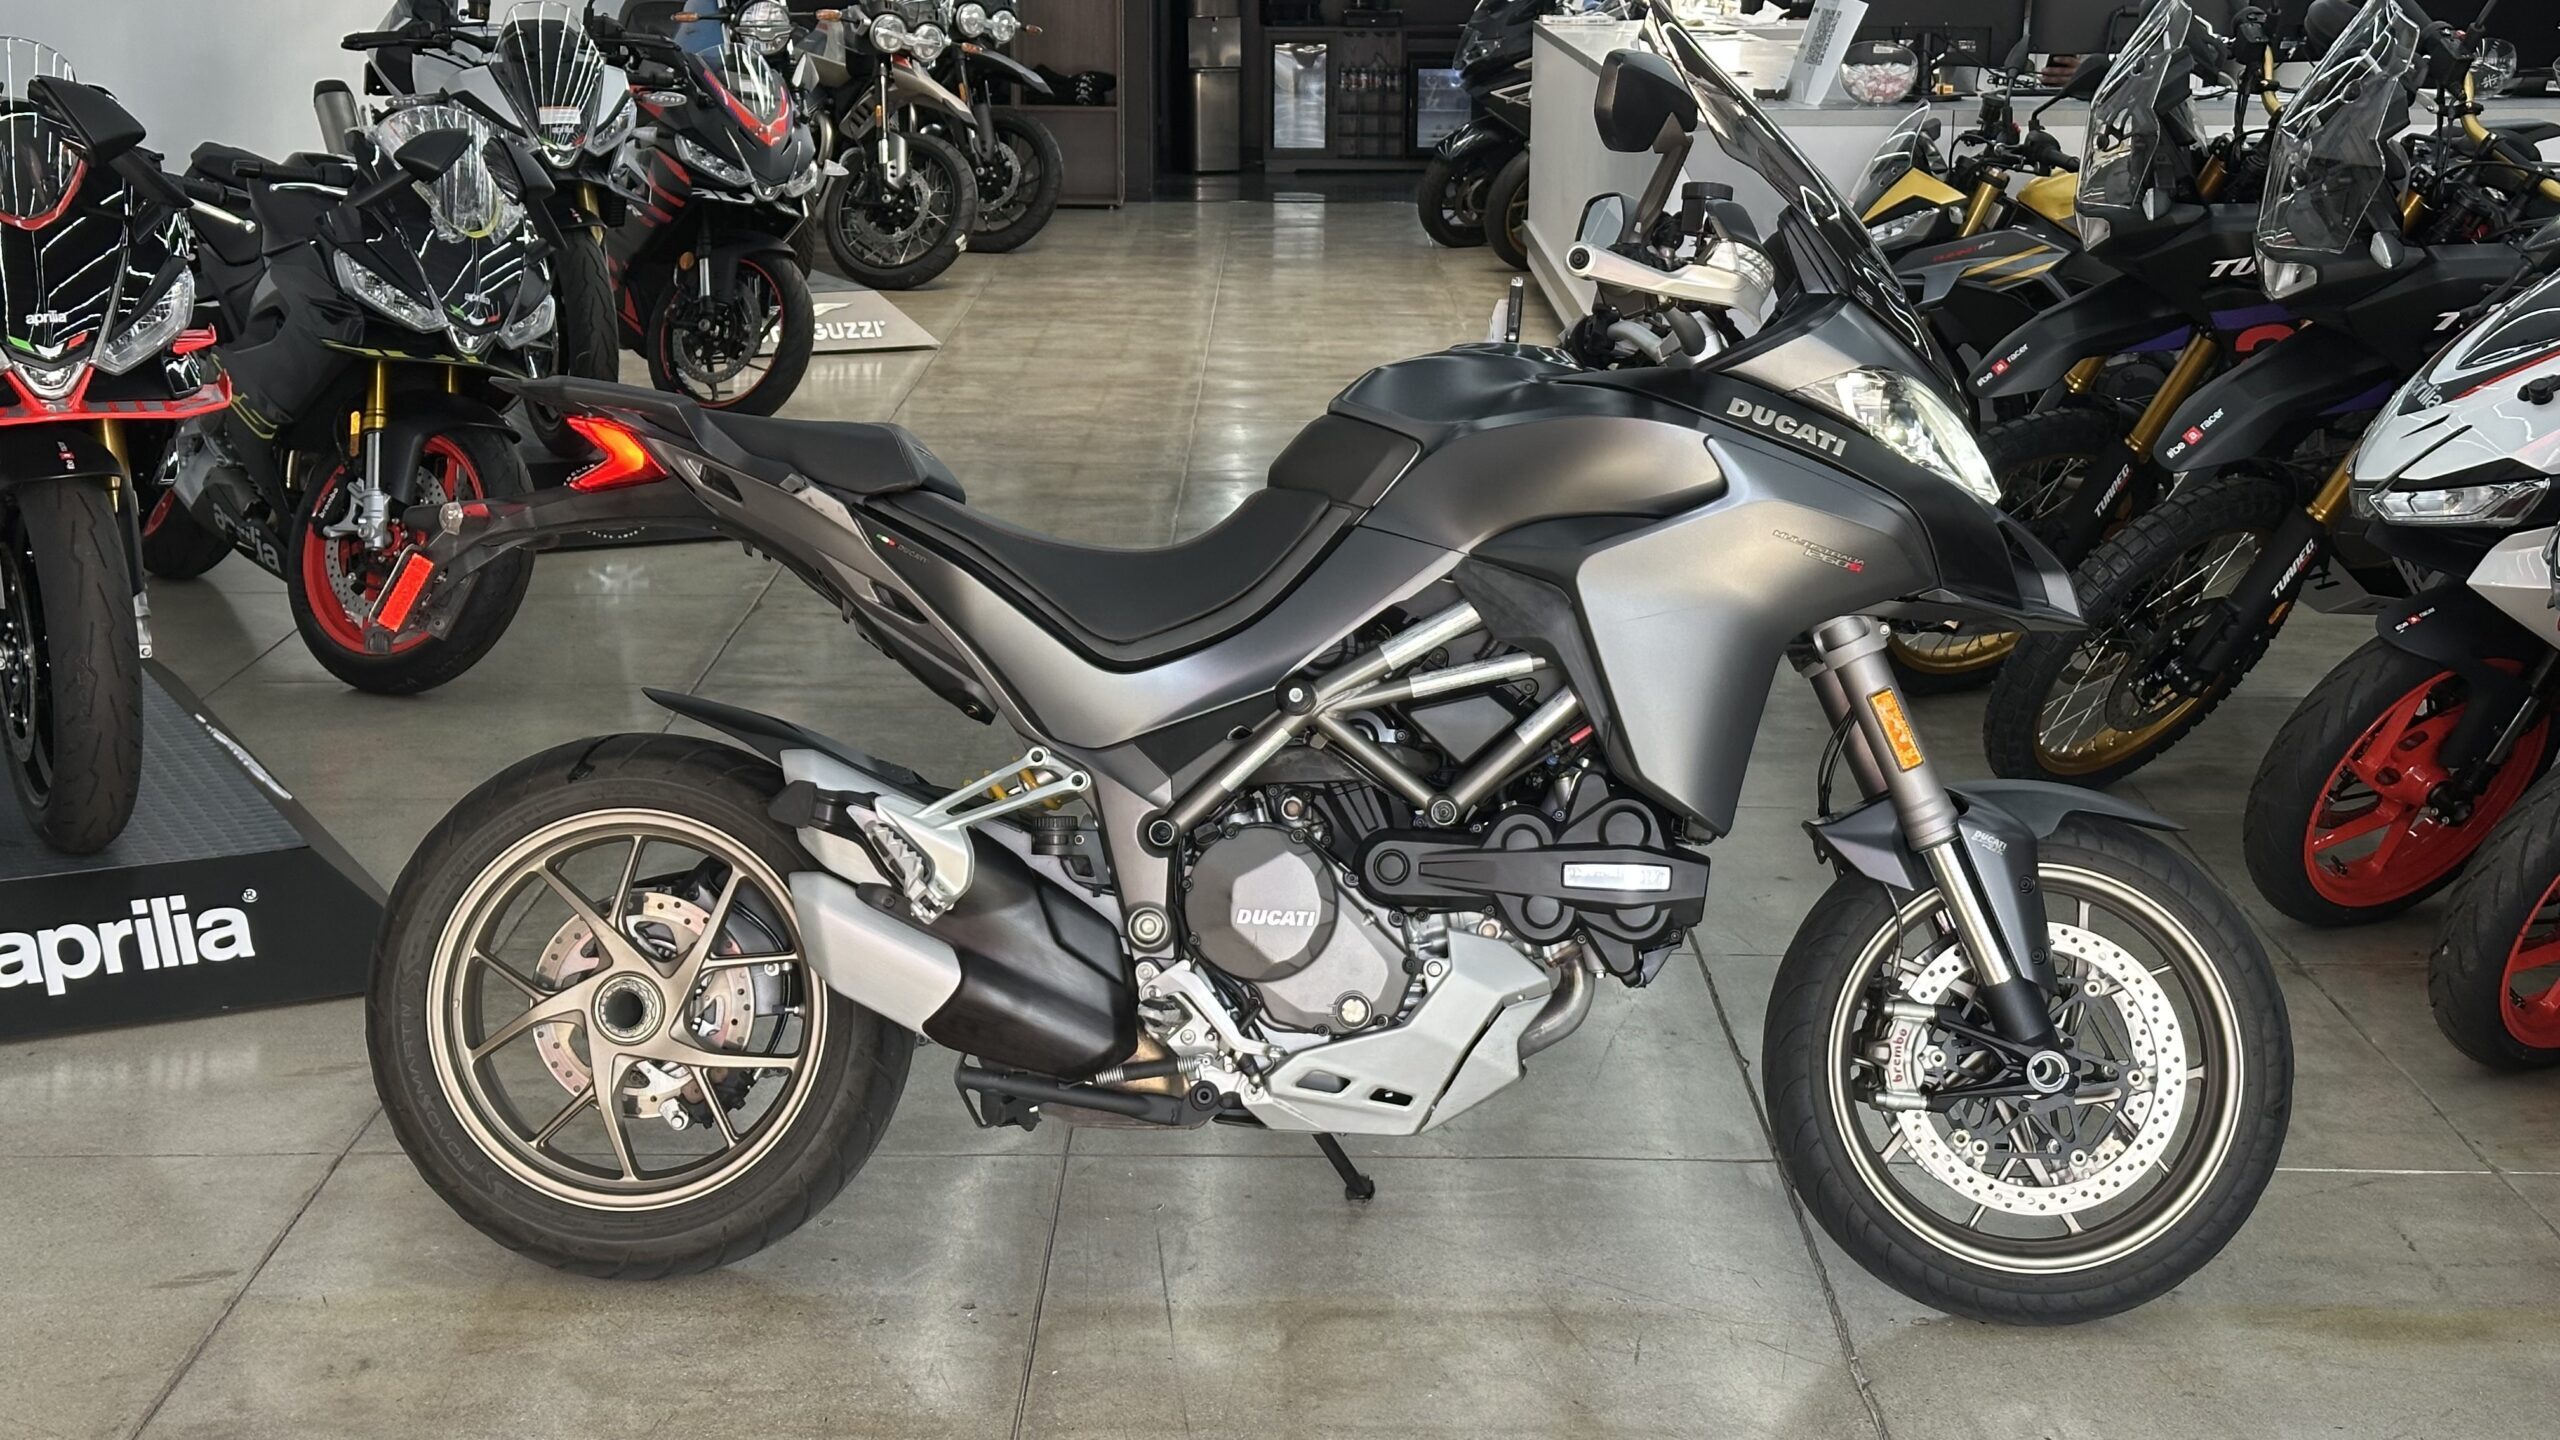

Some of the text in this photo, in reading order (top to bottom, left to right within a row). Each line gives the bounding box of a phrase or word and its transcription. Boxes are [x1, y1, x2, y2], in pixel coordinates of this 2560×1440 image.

[25, 310, 67, 326] aprilia
[2007, 344, 2029, 363] racer
[1726, 397, 1848, 457] DUCATI
[2200, 407, 2225, 431] racer
[2271, 537, 2315, 599] TUAREG
[1974, 829, 2008, 851] DUCATI
[1236, 908, 1317, 928] DUCATI
[1892, 1027, 1908, 1083] brembo
